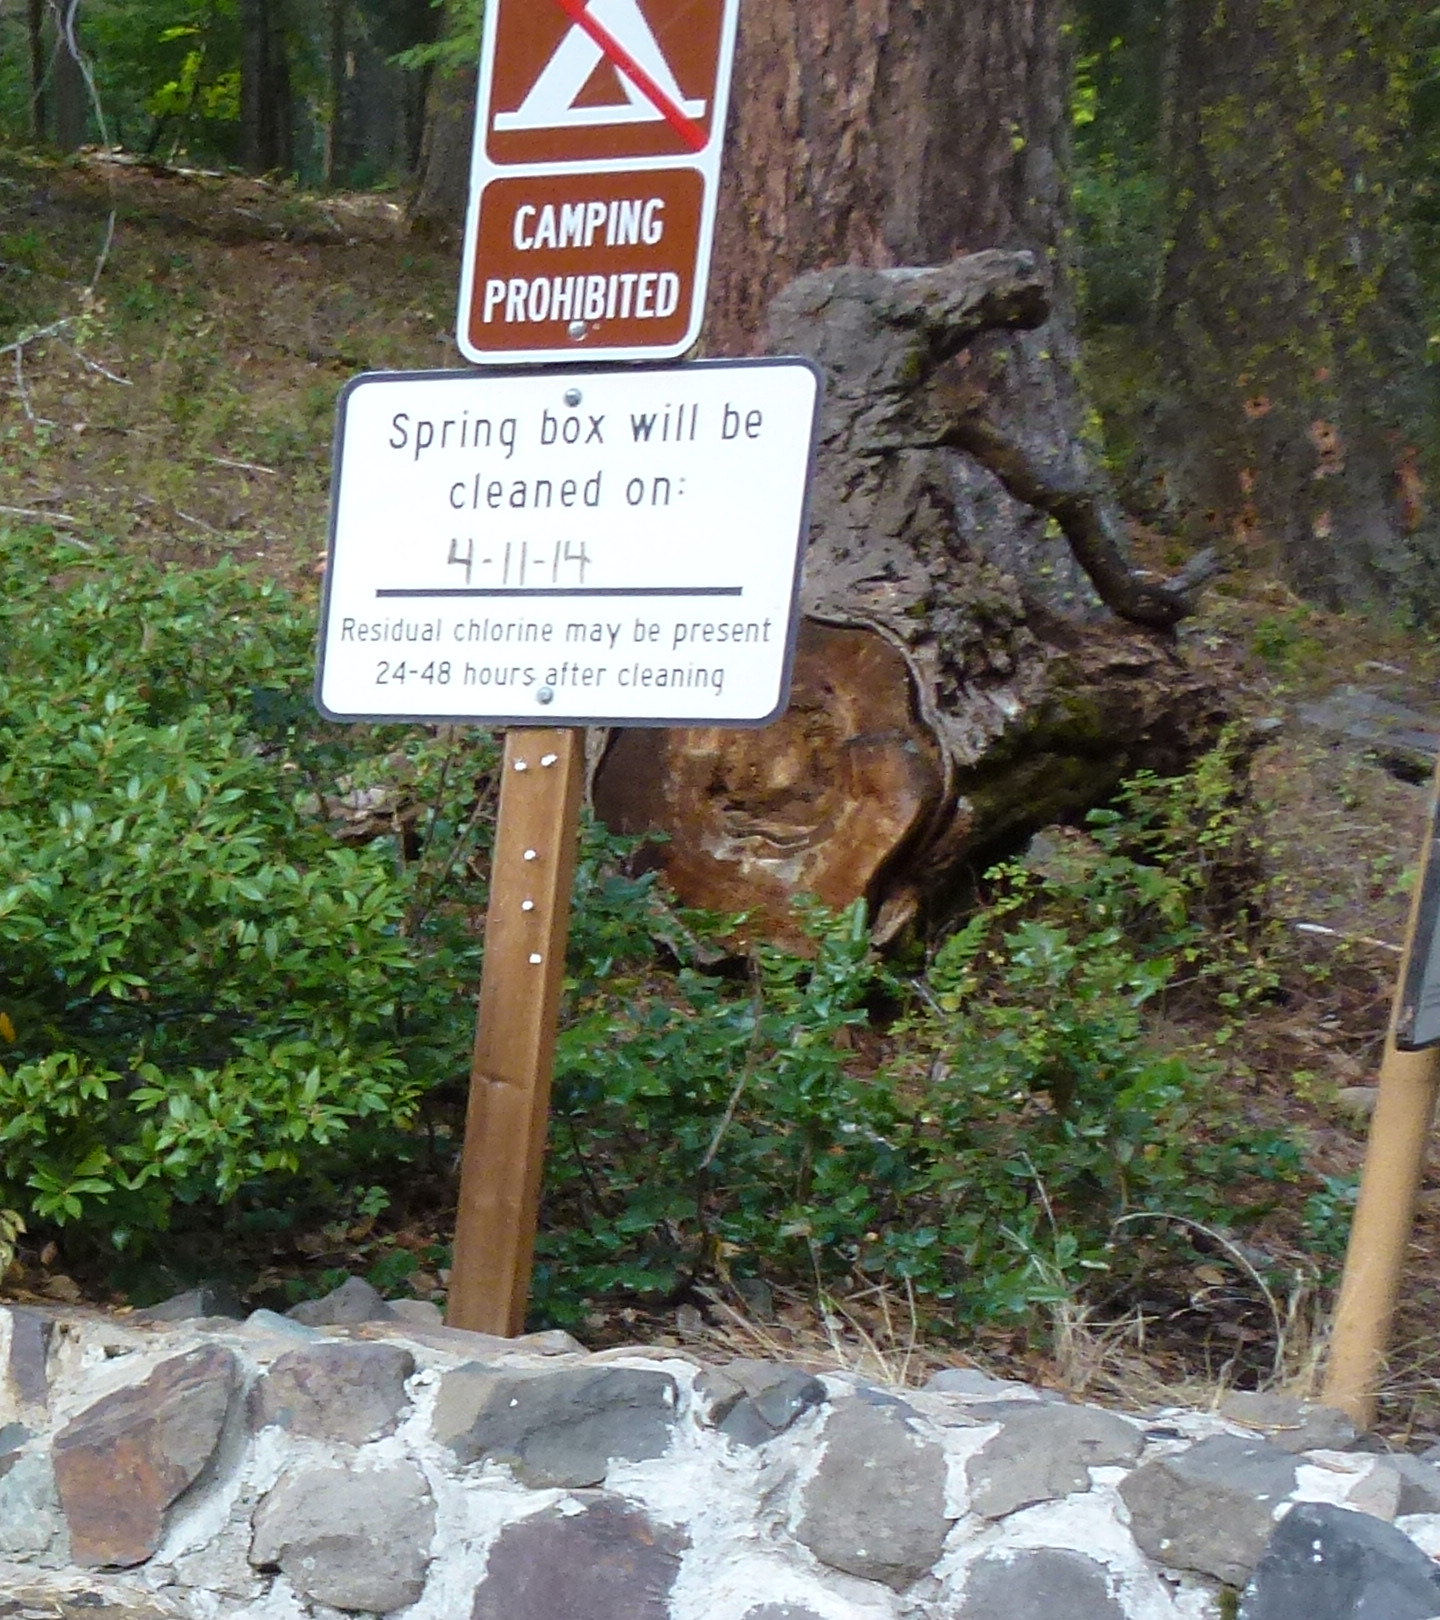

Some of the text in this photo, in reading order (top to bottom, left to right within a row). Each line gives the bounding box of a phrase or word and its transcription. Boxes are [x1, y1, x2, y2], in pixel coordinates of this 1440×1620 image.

[513, 198, 664, 250] CAMPING
[483, 272, 680, 324] PROHIBITED
[388, 402, 763, 461] Spring box will be
[449, 471, 686, 509] cleaned on:
[446, 538, 591, 585] 4-11-14
[341, 617, 771, 650] Residual chlorine may be present
[375, 661, 724, 694] 24-48 hours after cleaning
